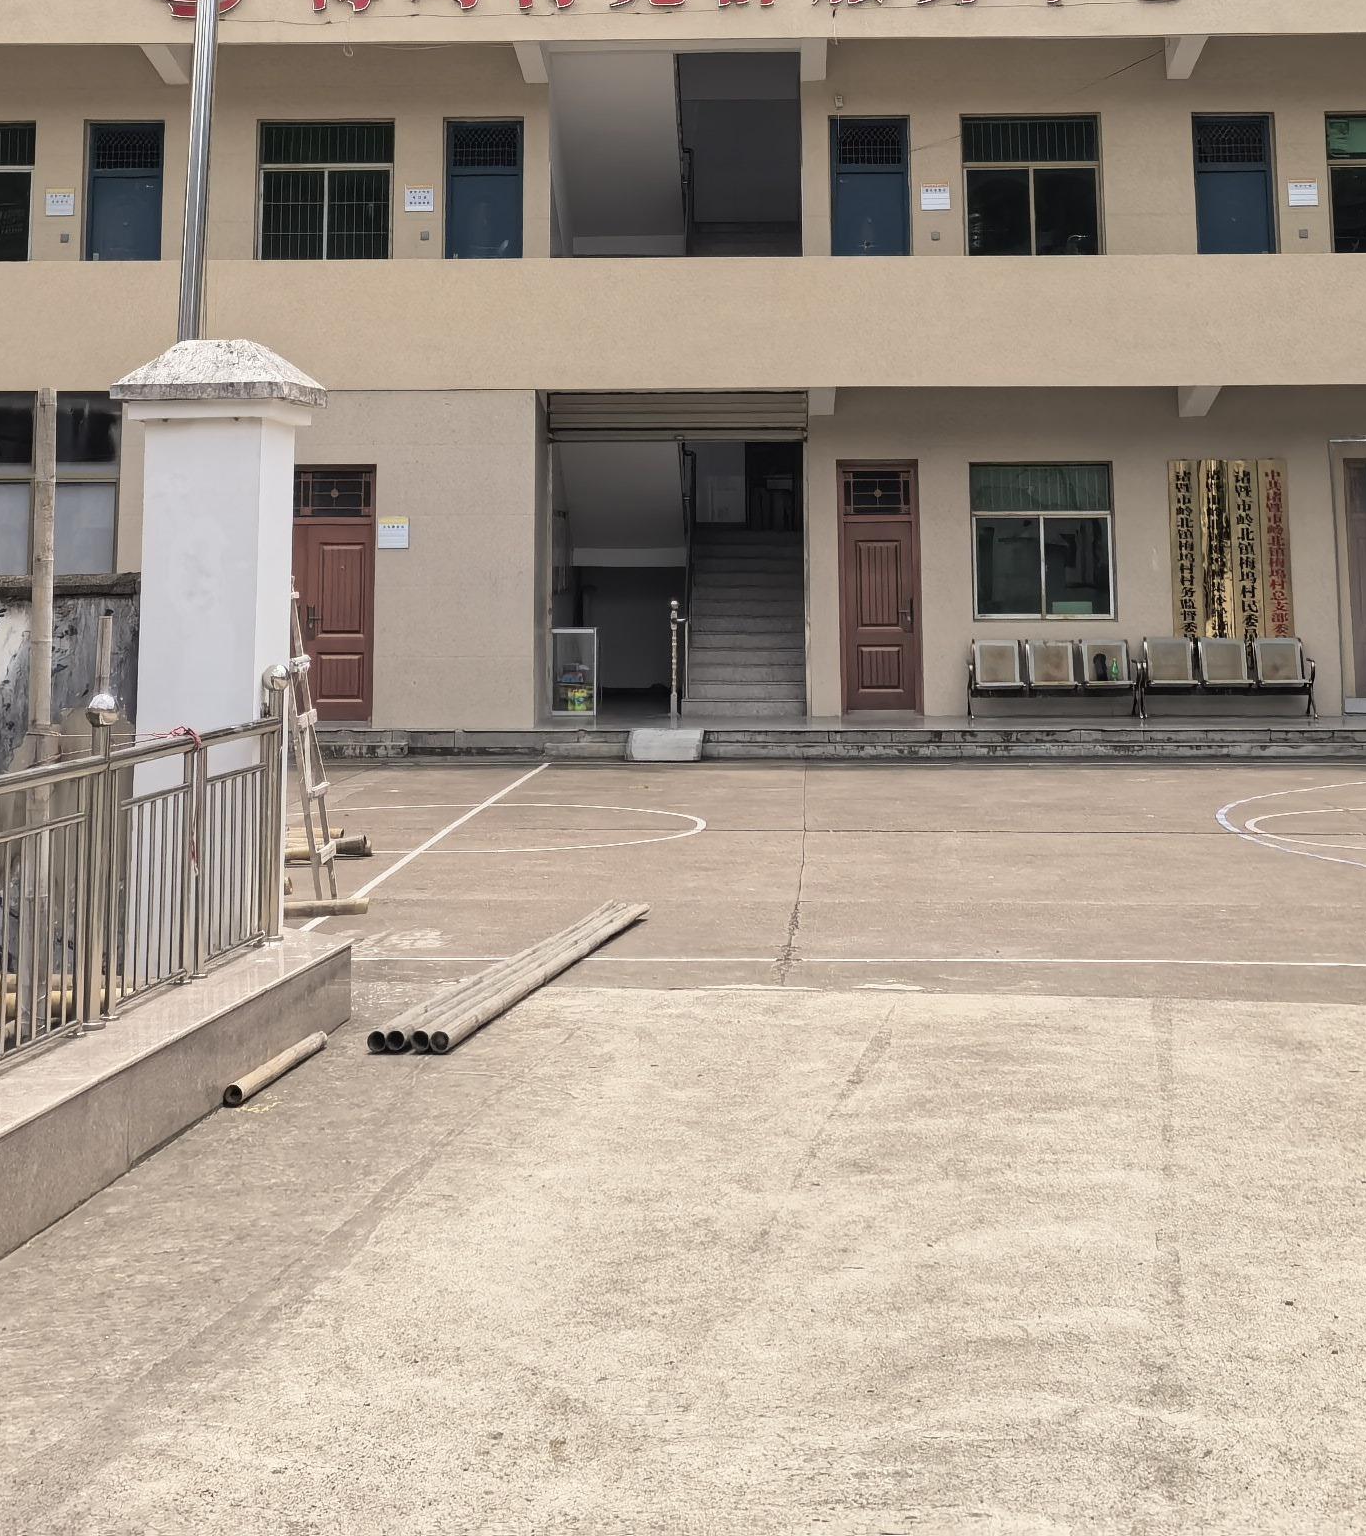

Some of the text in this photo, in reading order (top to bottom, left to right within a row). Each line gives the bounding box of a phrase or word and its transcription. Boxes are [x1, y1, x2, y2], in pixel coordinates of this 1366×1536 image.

[1265, 470, 1289, 638] 中共诸暨市岭北镇梅坞村总支部委
